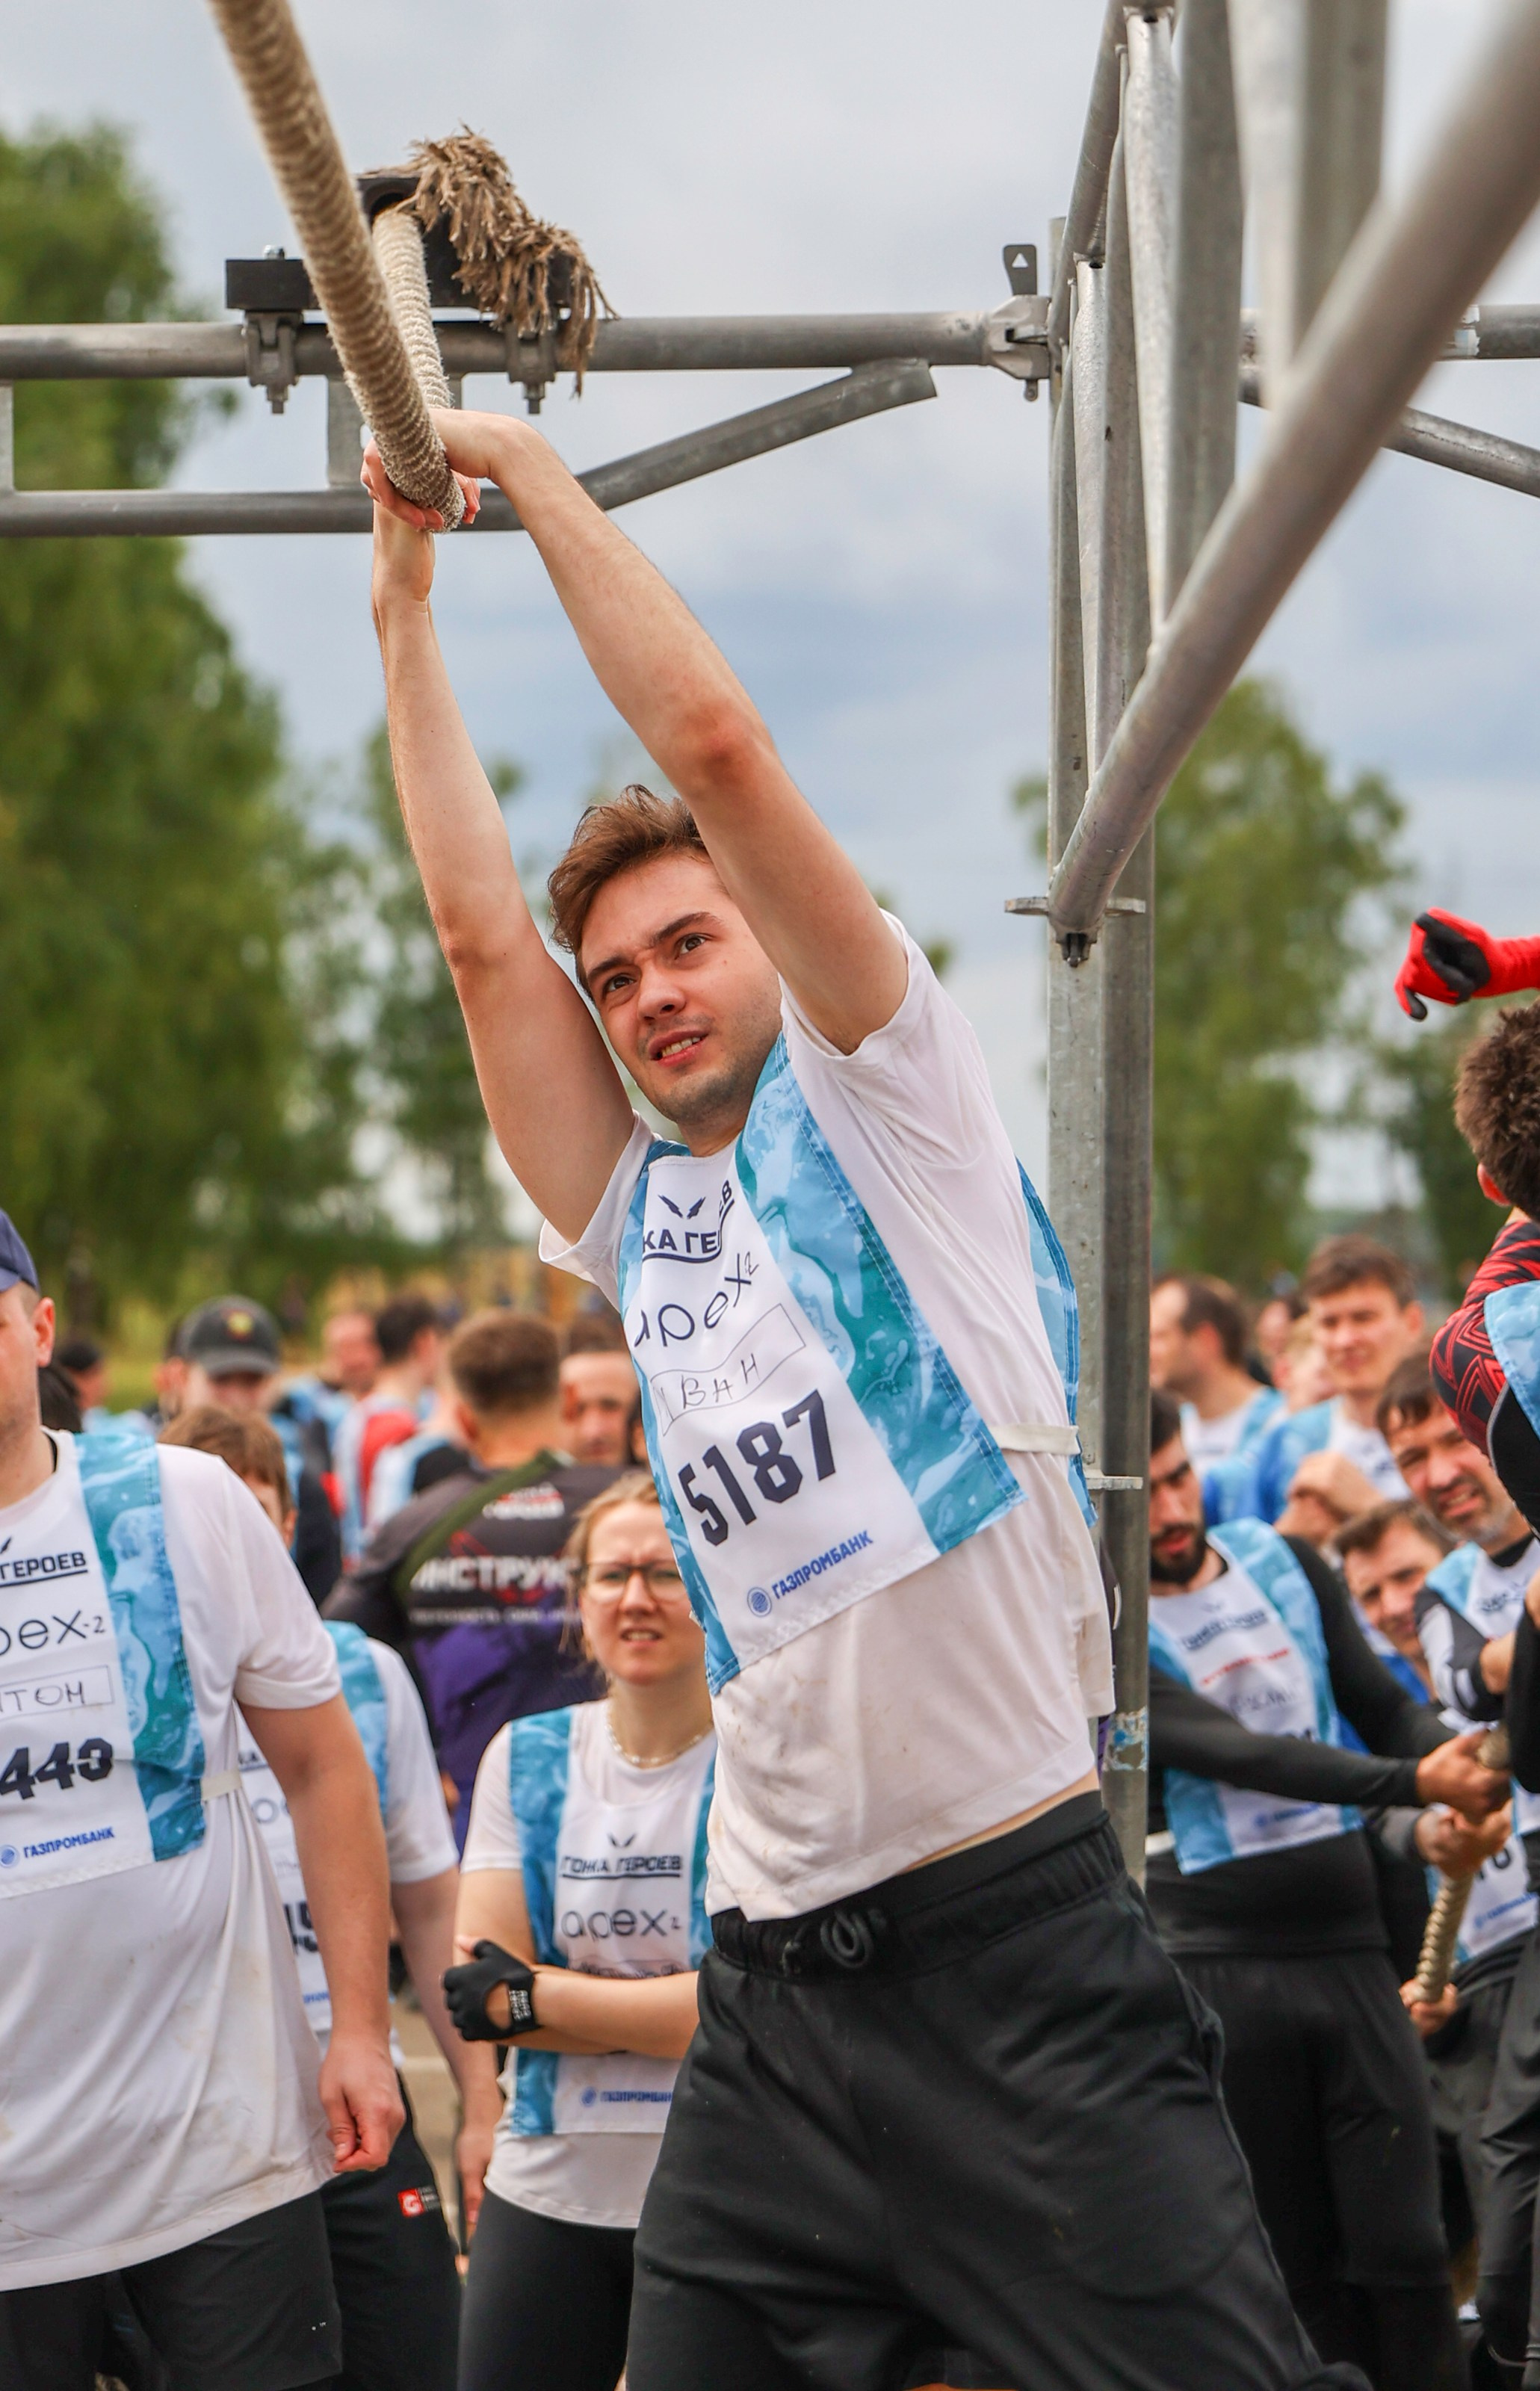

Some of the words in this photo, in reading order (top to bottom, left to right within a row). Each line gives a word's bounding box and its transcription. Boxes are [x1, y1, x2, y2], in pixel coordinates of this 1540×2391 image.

[678, 1388, 836, 1547] 5187
[771, 1529, 873, 1600] ГАЗПРОМБАНК
[0, 1681, 85, 1713] ТОН
[23, 1827, 115, 1858] ГАЗПРОМБАНК
